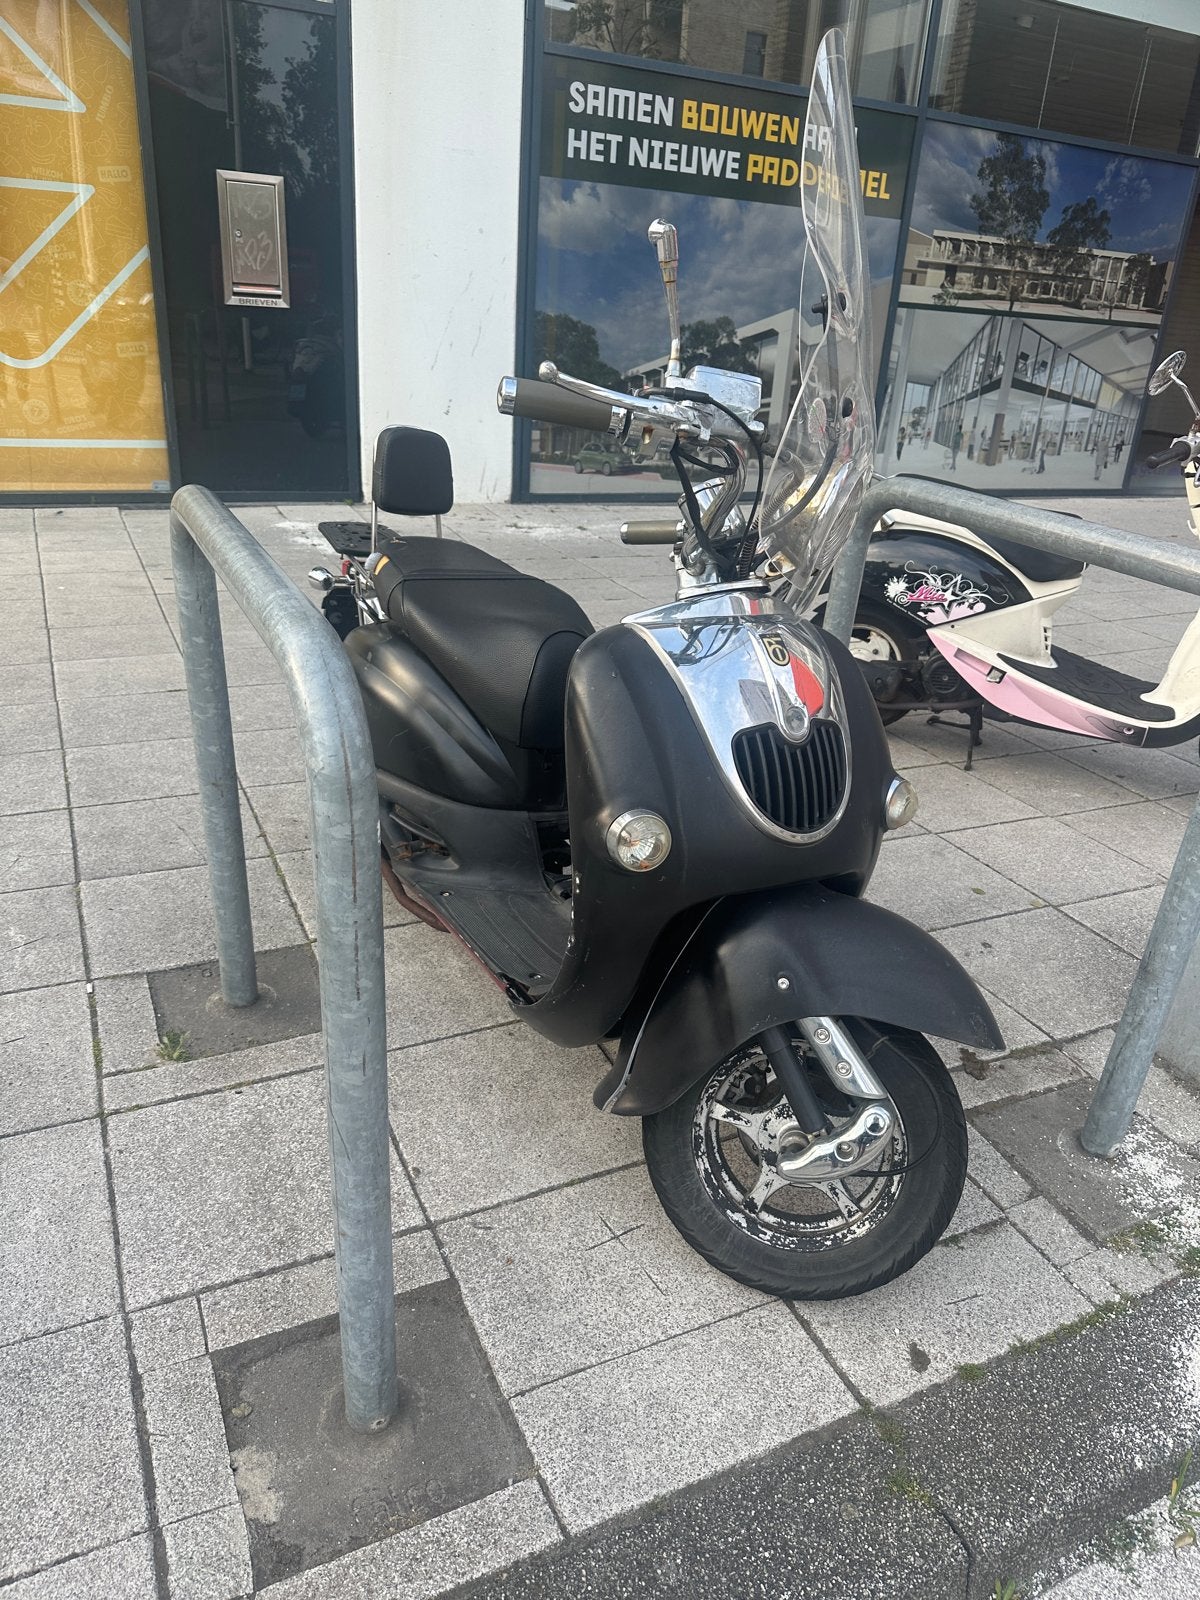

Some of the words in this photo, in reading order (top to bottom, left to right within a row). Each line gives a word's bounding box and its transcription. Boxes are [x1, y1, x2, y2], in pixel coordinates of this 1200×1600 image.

[568, 80, 675, 127] SAMEN
[681, 98, 800, 146] BOUWEN
[804, 123, 858, 152] AA
[567, 127, 623, 164] HET
[628, 136, 741, 180] NIEUWE
[100, 168, 129, 179] HALLO
[238, 297, 279, 306] BRIEVEN
[907, 585, 948, 602] Mia
